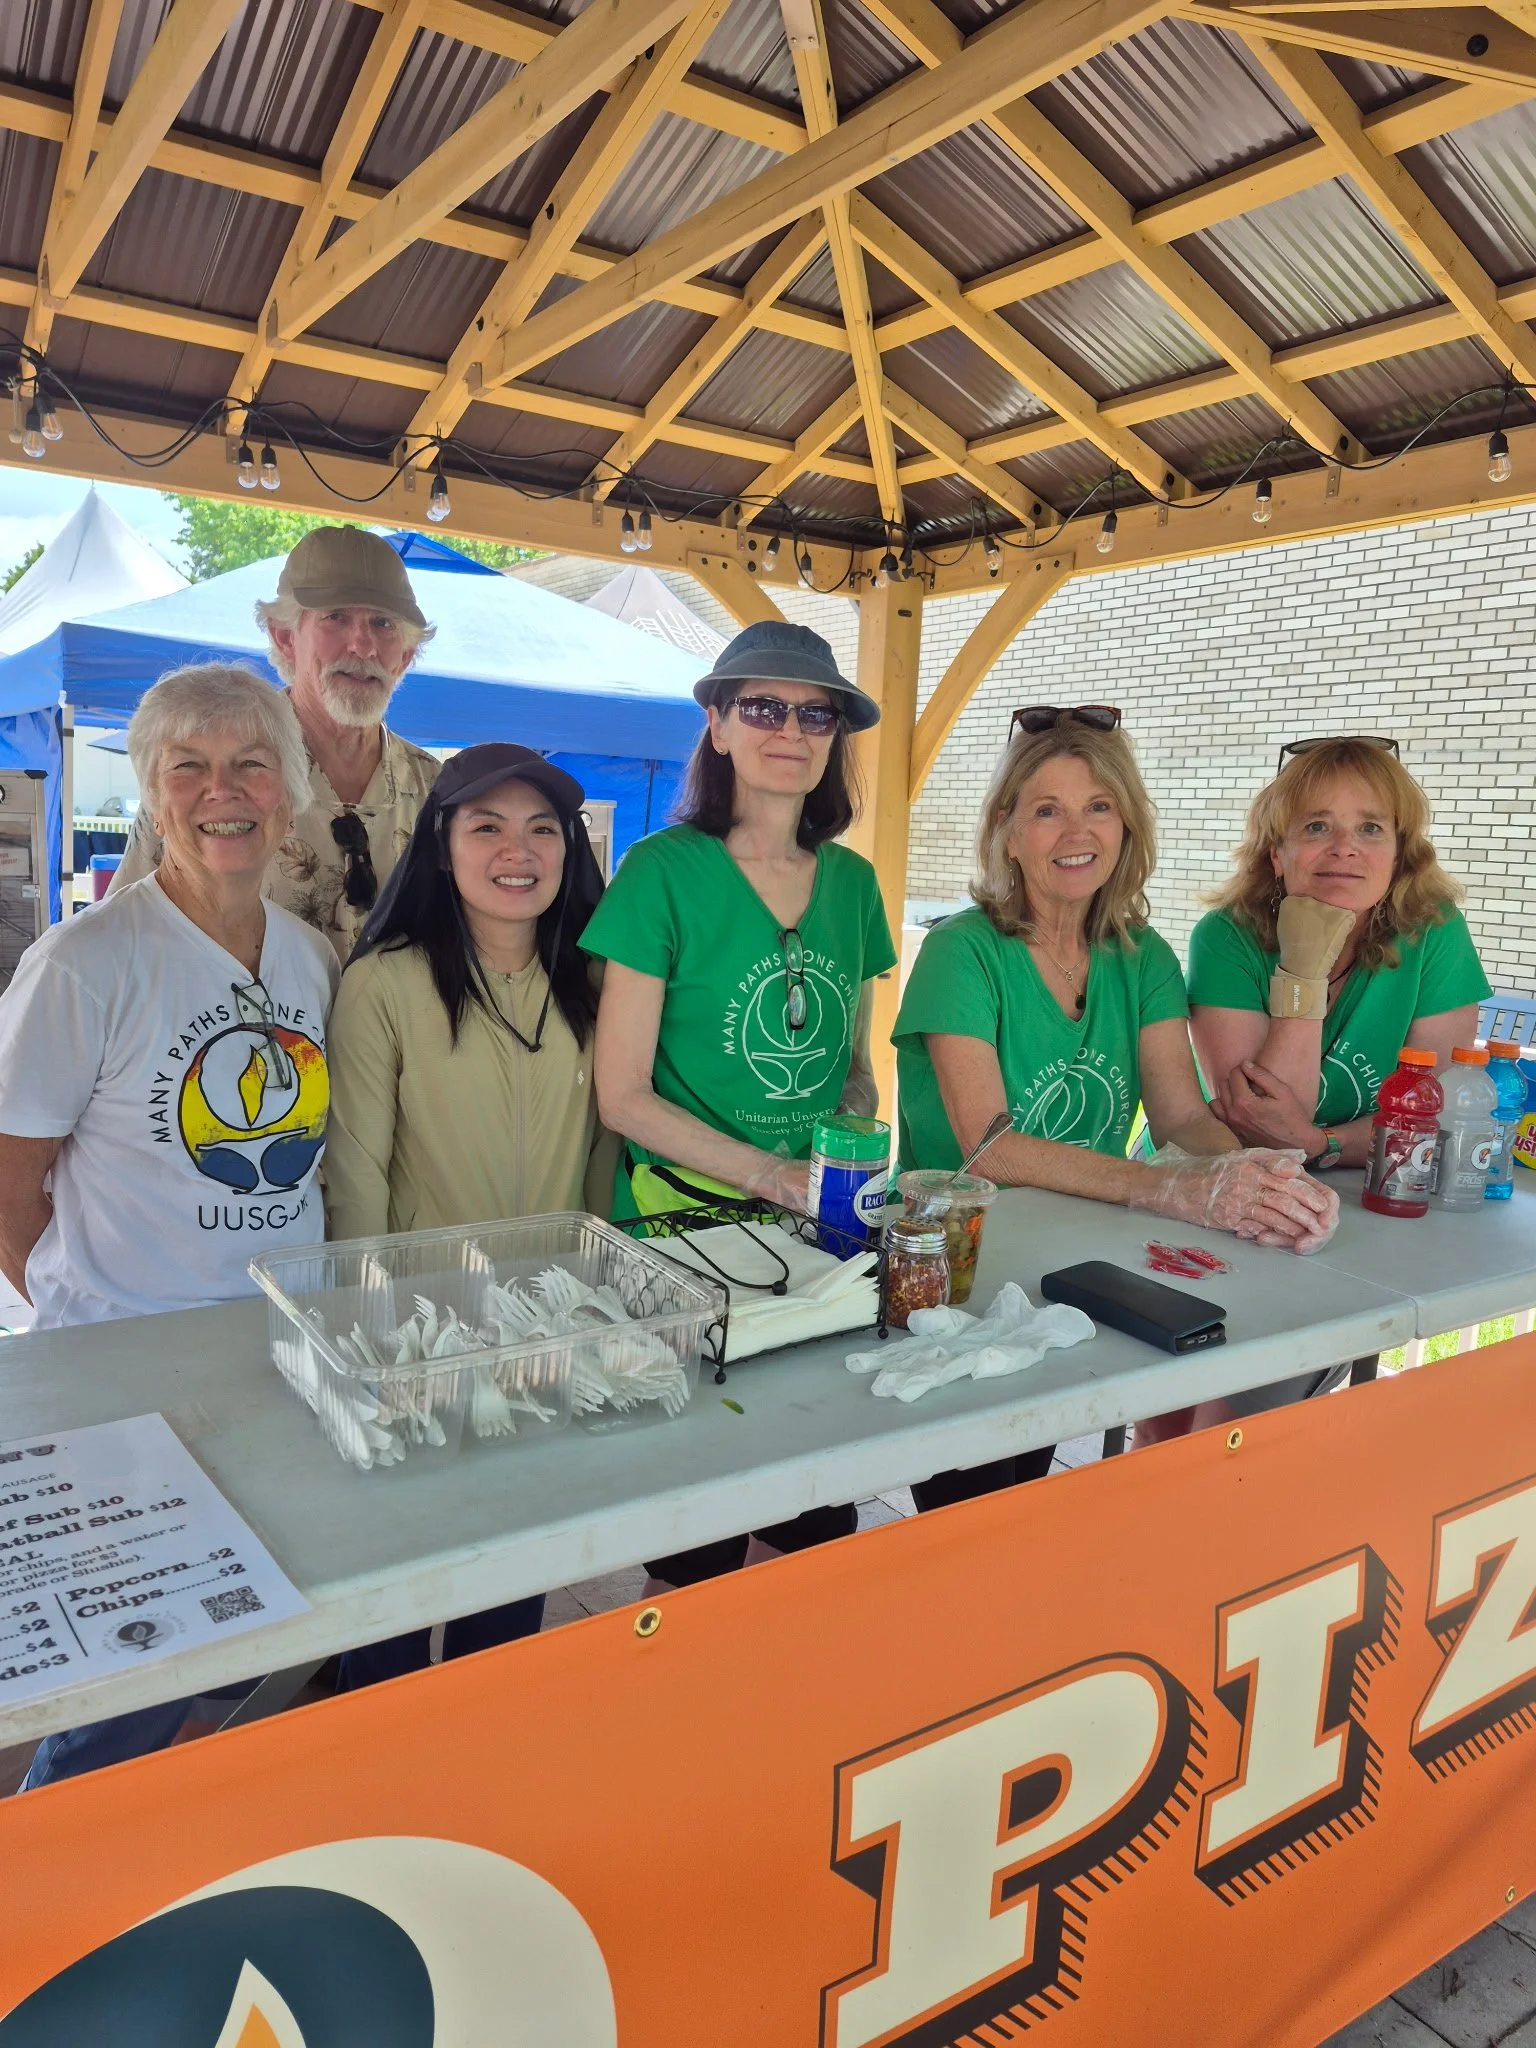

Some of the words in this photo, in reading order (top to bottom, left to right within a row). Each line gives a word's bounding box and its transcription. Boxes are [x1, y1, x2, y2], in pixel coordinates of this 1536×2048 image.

[722, 998, 741, 1055] MANY
[738, 952, 781, 994] PATHS
[803, 949, 835, 973] ONE
[147, 1071, 174, 1143] MANY
[167, 1004, 231, 1061] PATHS
[262, 1000, 306, 1025] ONE
[1024, 1058, 1067, 1099] PATHS
[1076, 1047, 1107, 1067] ONE
[1109, 1066, 1131, 1135] CHURCH
[735, 1109, 788, 1124] Unitarian
[791, 1107, 837, 1122] Univers
[1457, 1174, 1488, 1185] FROST
[0, 1472, 57, 1489] AUSAGE
[0, 1493, 30, 1507] ub
[36, 1482, 74, 1497] $10
[0, 1519, 18, 1533] ef
[24, 1506, 81, 1526] Sub
[87, 1495, 125, 1510] $10
[0, 1522, 84, 1551] atball
[88, 1508, 144, 1528] Sub
[149, 1497, 188, 1512] $12
[17, 1556, 69, 1573] chips,
[70, 1545, 103, 1559] and
[119, 1528, 167, 1546] water
[169, 1523, 188, 1533] or
[22, 1565, 70, 1583] pizza
[71, 1557, 97, 1569] for
[99, 1550, 120, 1561] $3
[50, 1574, 70, 1585] or
[71, 1553, 145, 1578] Slushie).
[820, 1472, 1536, 2048] PIZ
